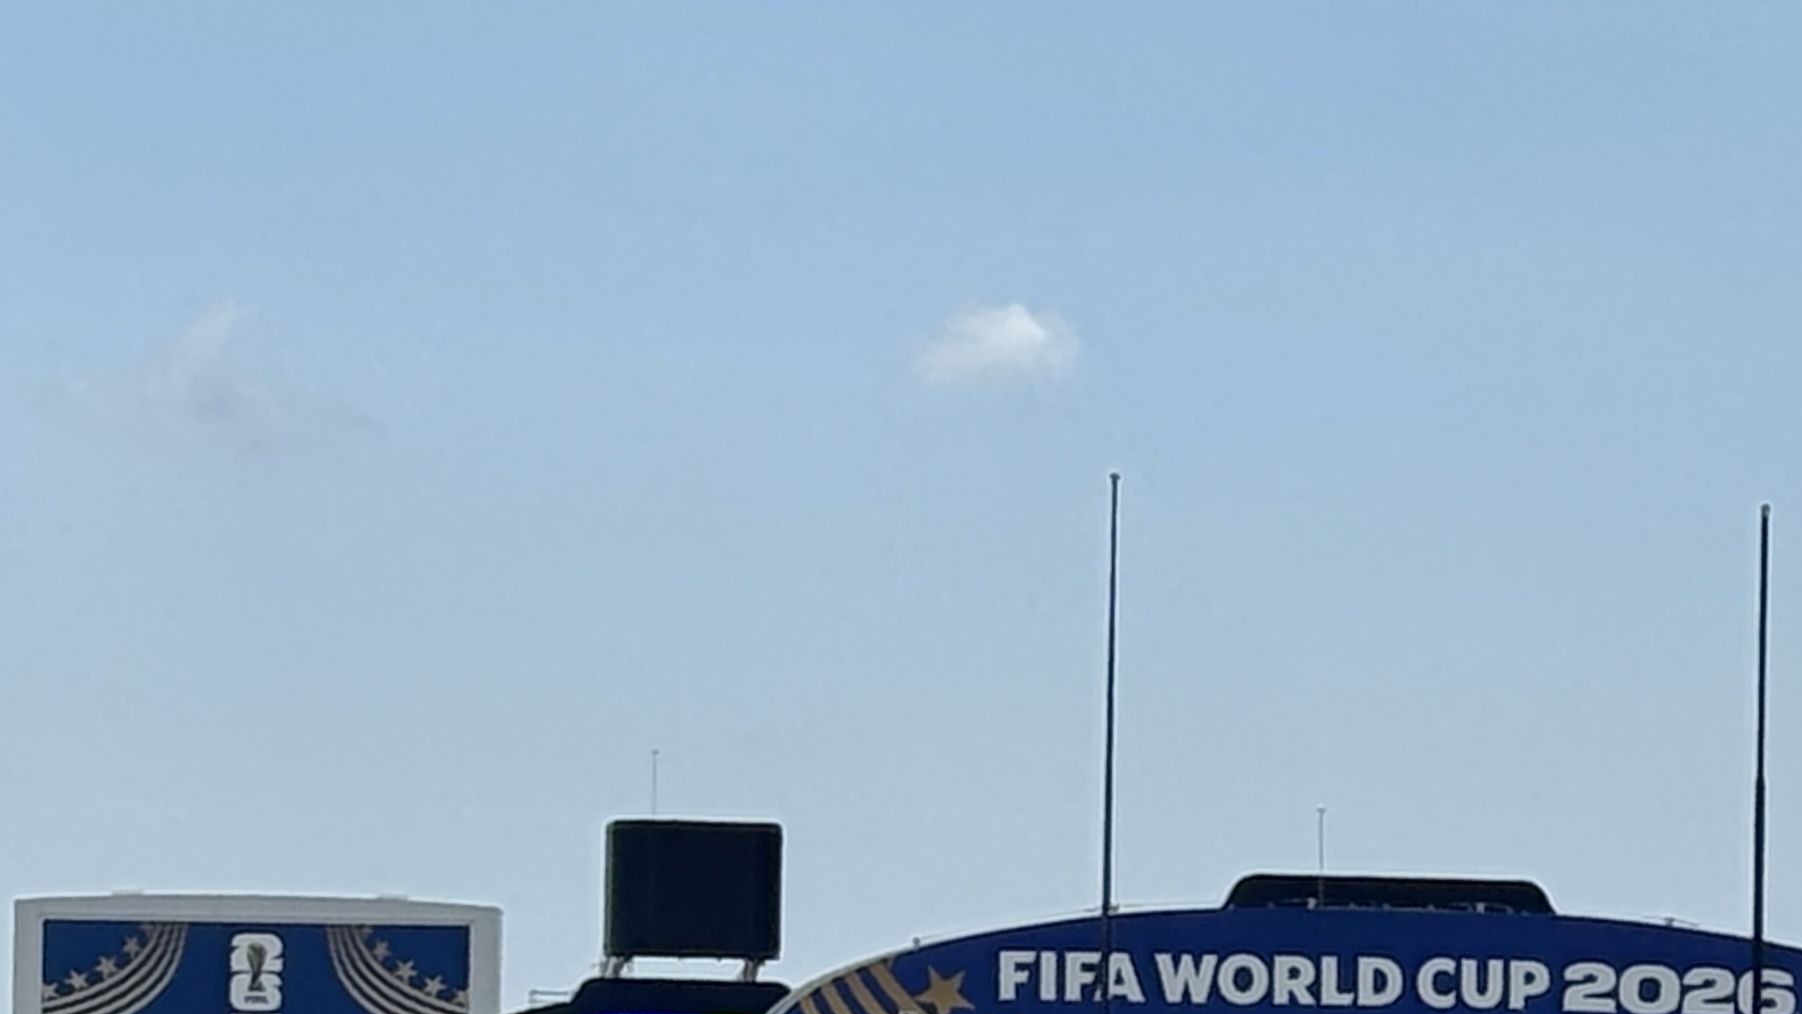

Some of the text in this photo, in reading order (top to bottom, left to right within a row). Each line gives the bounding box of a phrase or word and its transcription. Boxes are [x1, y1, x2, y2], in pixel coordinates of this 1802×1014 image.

[998, 950, 1147, 1003] FIFA
[1154, 952, 1404, 1007] WORLD
[1416, 957, 1551, 1010] CUP
